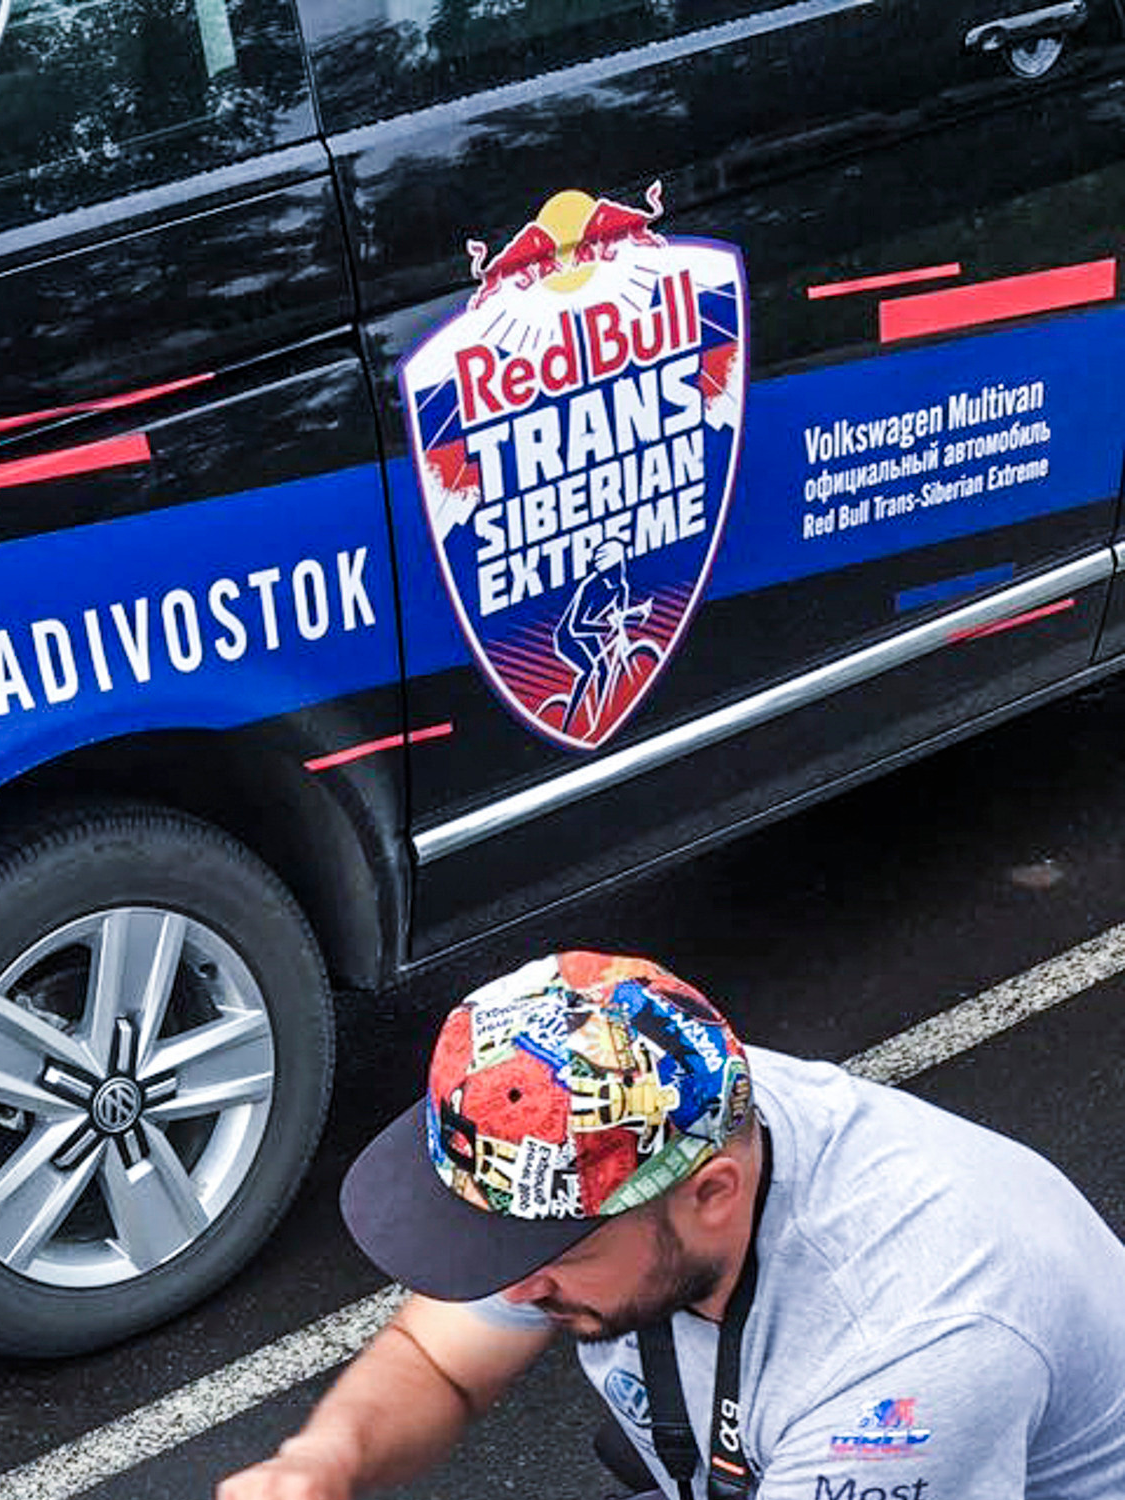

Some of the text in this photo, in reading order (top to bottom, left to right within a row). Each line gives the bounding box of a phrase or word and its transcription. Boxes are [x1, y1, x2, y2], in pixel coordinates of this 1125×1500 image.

[455, 270, 697, 422] Red Bull
[466, 354, 703, 503] TRANS
[804, 382, 1044, 464] Volkswagen Multivan
[805, 421, 1050, 502] официальный автомобиль
[475, 428, 704, 564] SIBERIAN
[803, 458, 1049, 539] Red Bull Trans-Siberian Extreme
